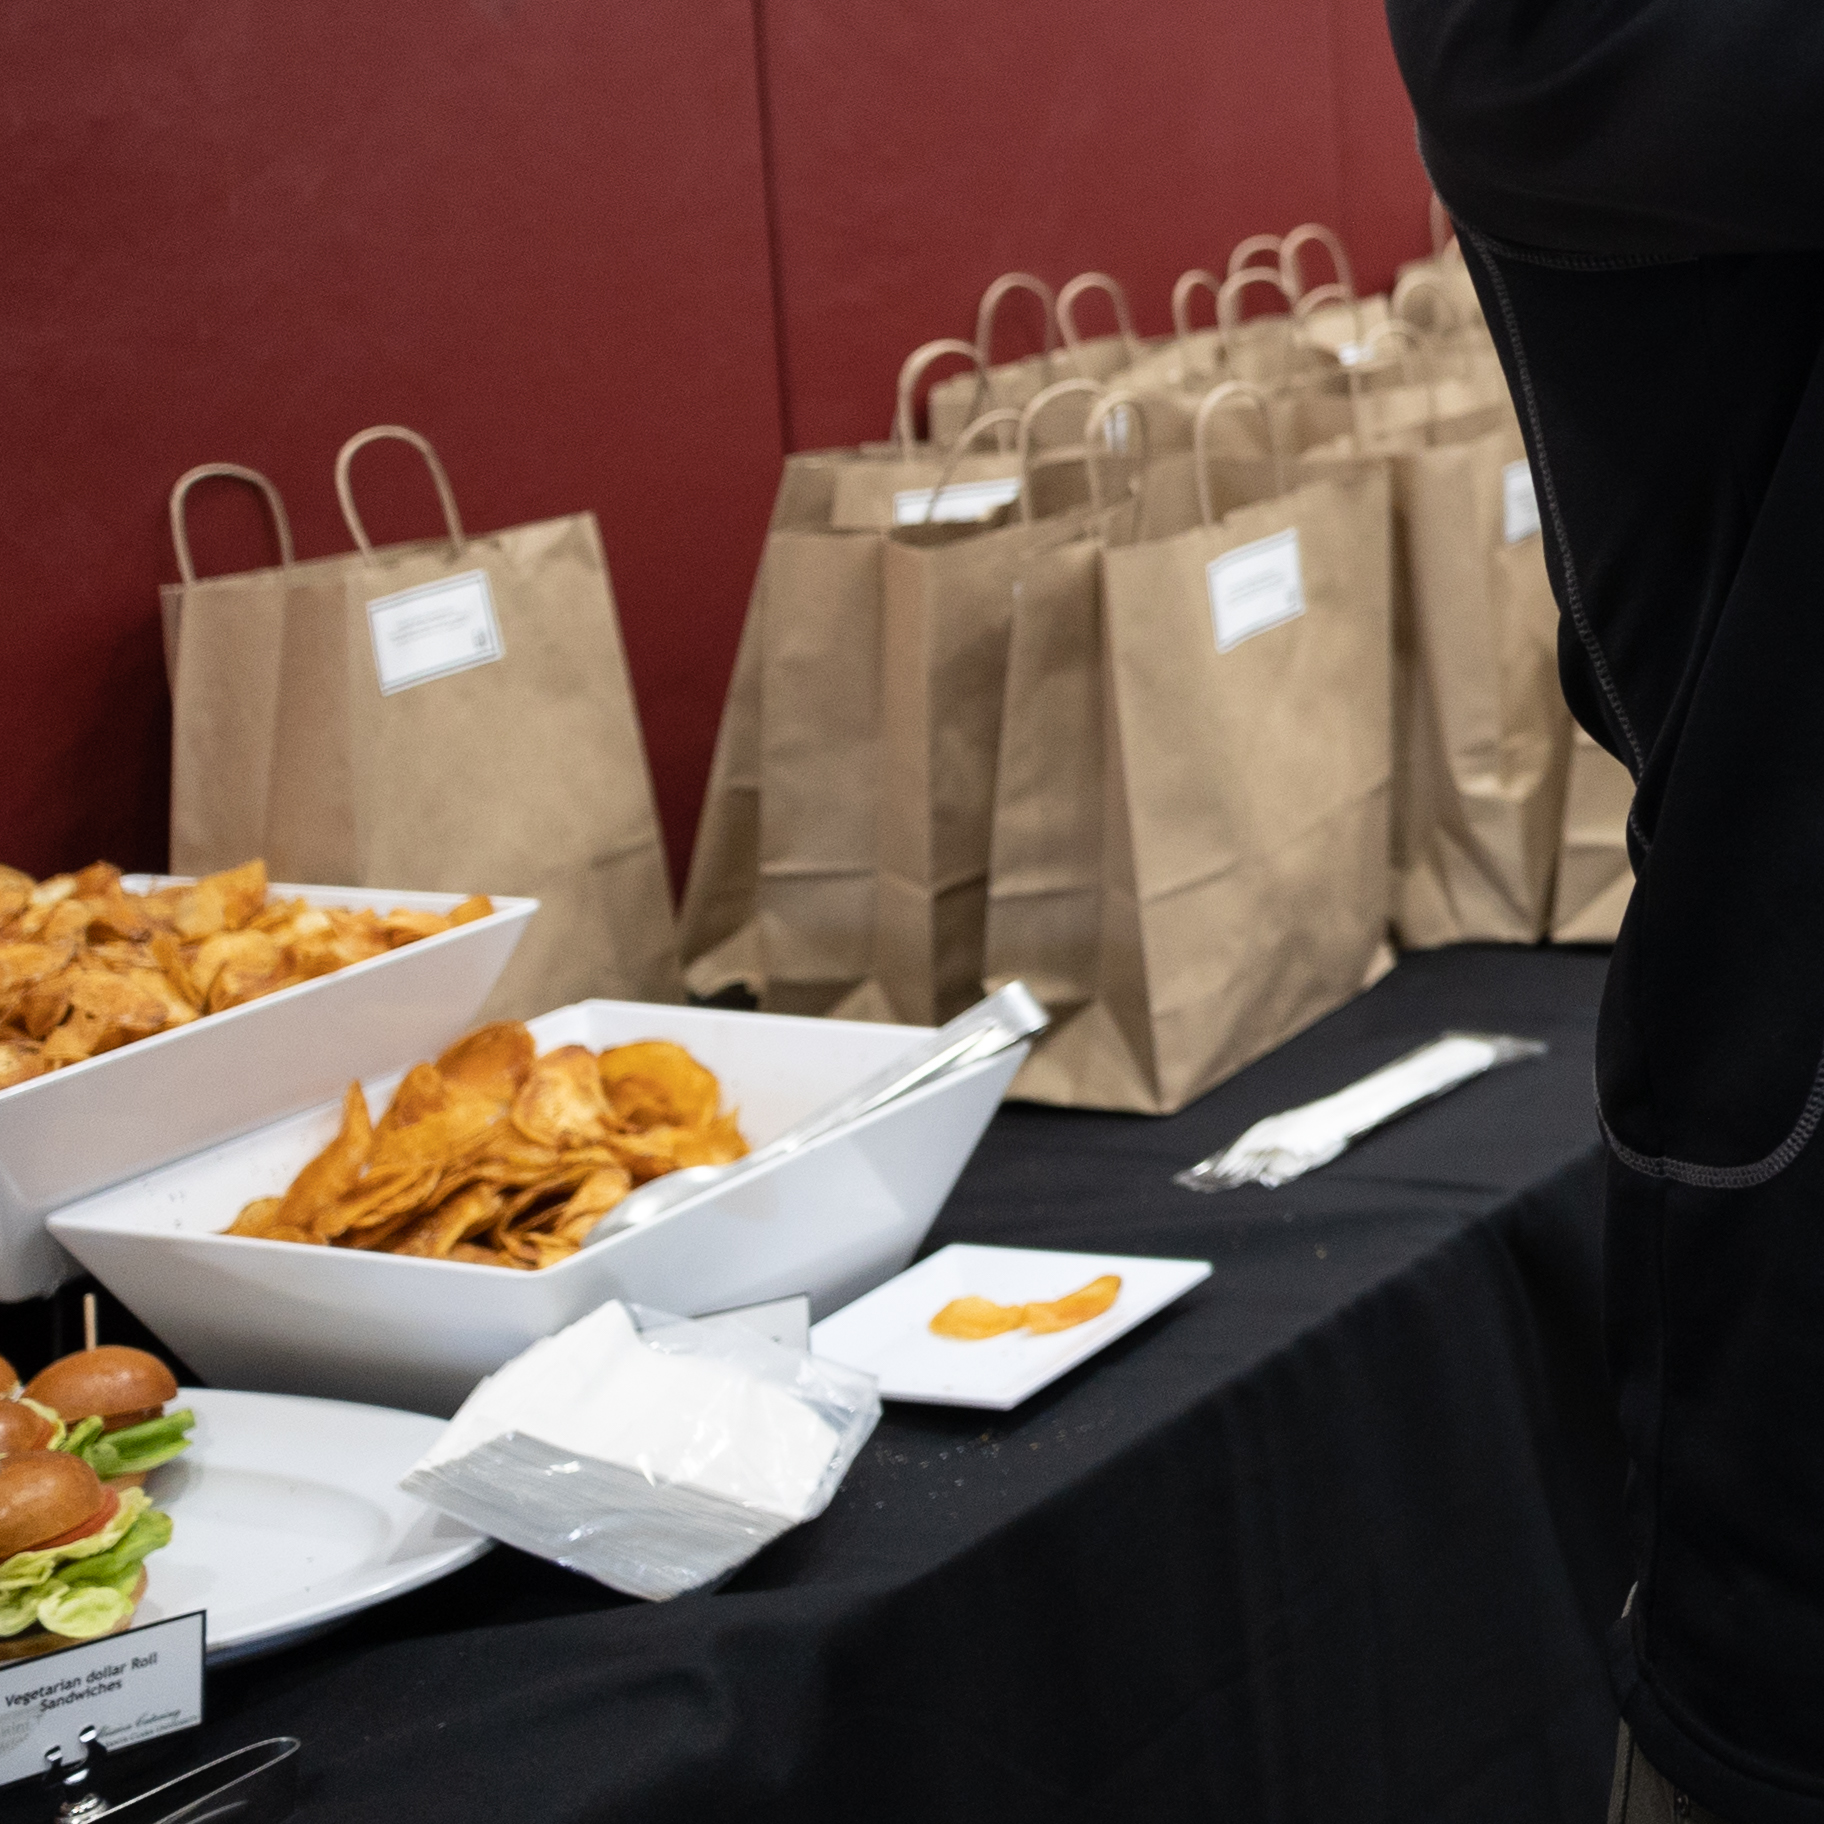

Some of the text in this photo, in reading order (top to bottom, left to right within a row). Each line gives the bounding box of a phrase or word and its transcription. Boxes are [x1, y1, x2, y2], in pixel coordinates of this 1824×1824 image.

[5, 1677, 82, 1707] Vegetarian
[131, 1651, 158, 1670] Roll
[39, 1679, 123, 1713] Sandwiches
